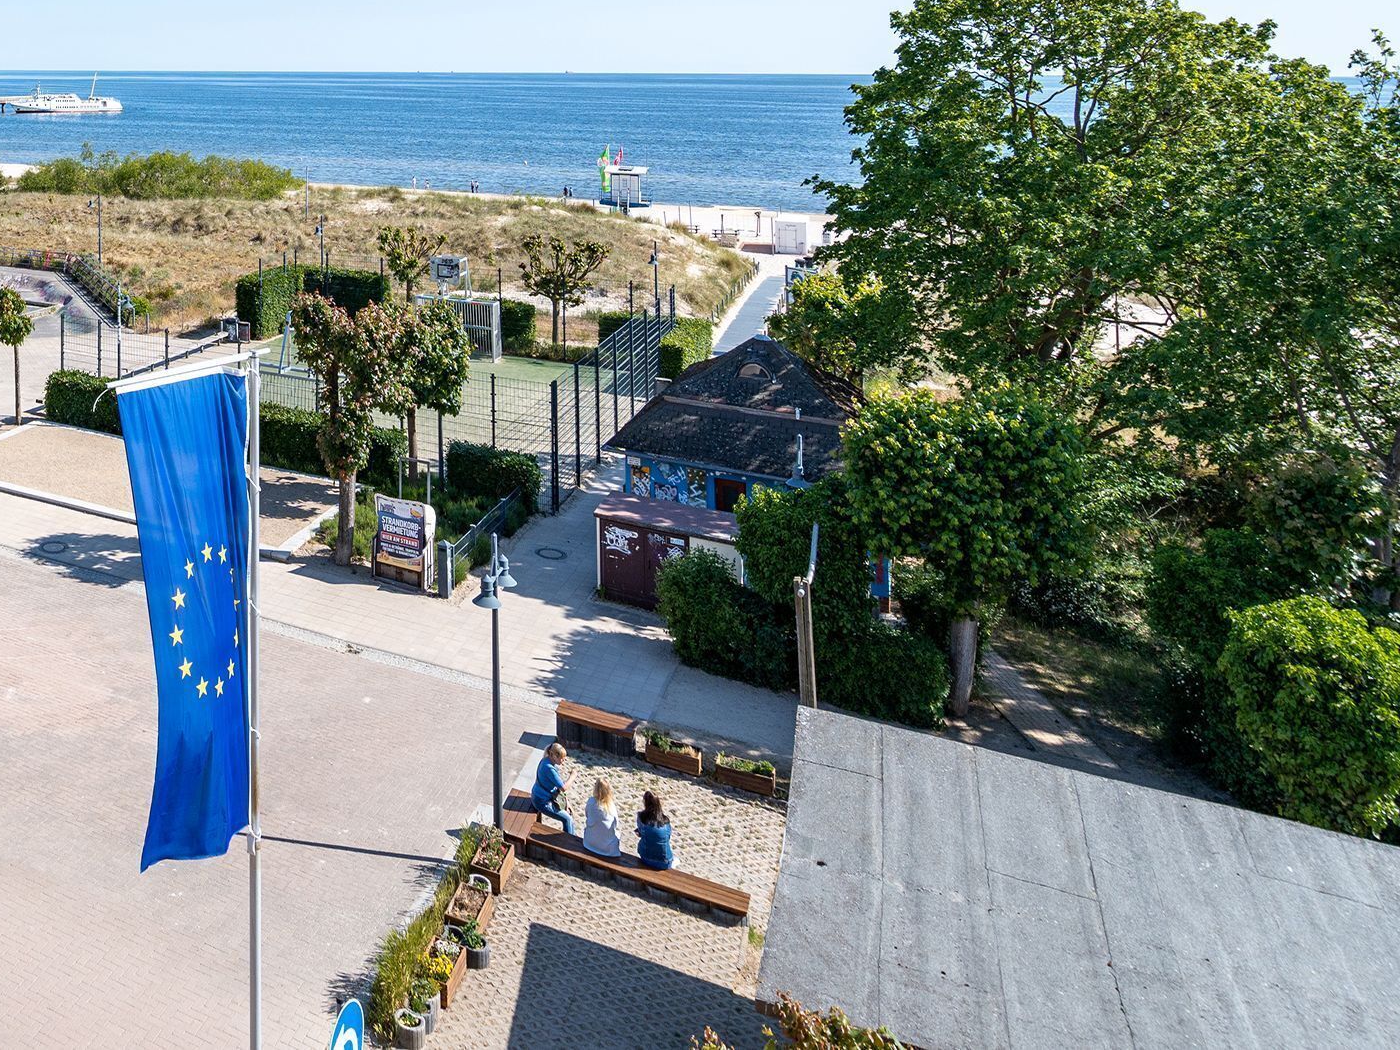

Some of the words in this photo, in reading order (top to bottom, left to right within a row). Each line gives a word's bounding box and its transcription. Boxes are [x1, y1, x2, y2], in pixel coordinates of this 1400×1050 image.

[381, 515, 421, 531] STRANDKORB-
[382, 523, 419, 538] VERMIETUNG
[400, 538, 418, 547] STRAND
